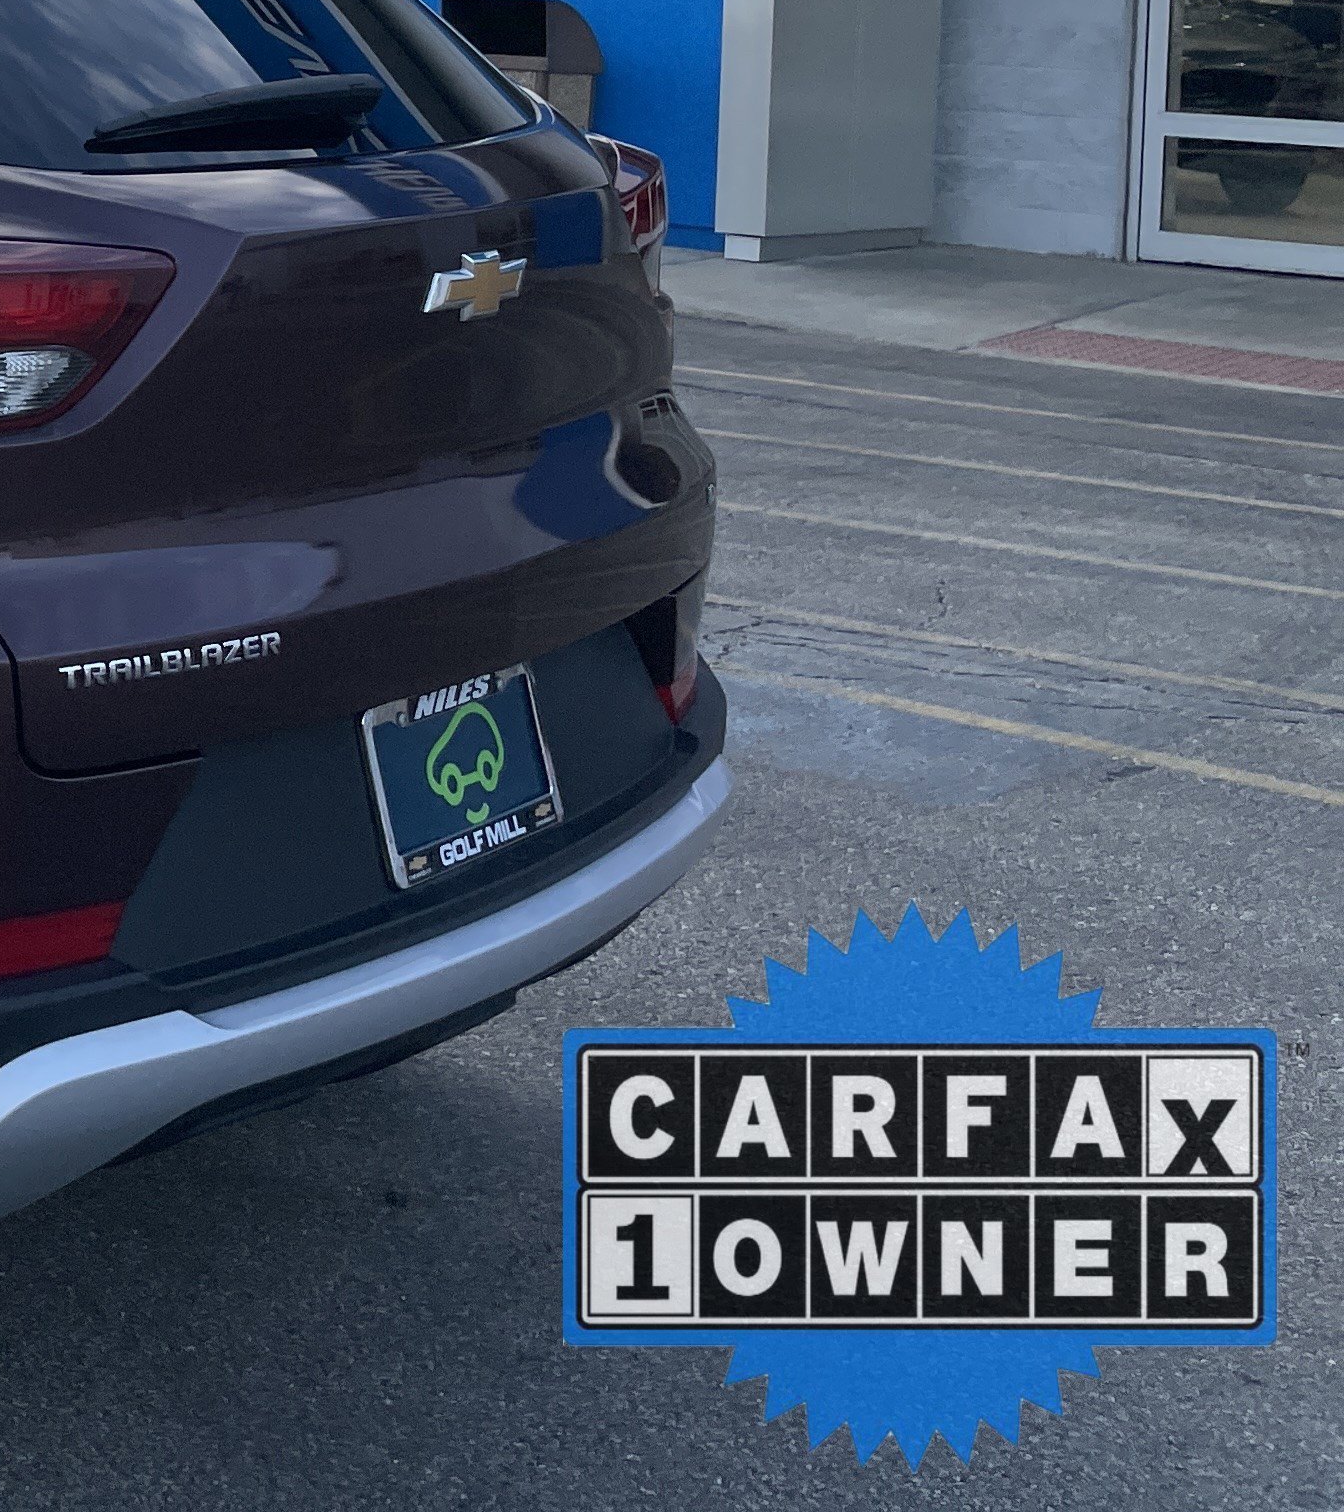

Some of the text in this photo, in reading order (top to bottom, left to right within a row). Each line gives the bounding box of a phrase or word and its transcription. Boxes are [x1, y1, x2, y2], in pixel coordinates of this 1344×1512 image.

[58, 631, 281, 689] TRAILBLAZER
[414, 674, 491, 720] NILES
[439, 815, 527, 867] GOLF MILL
